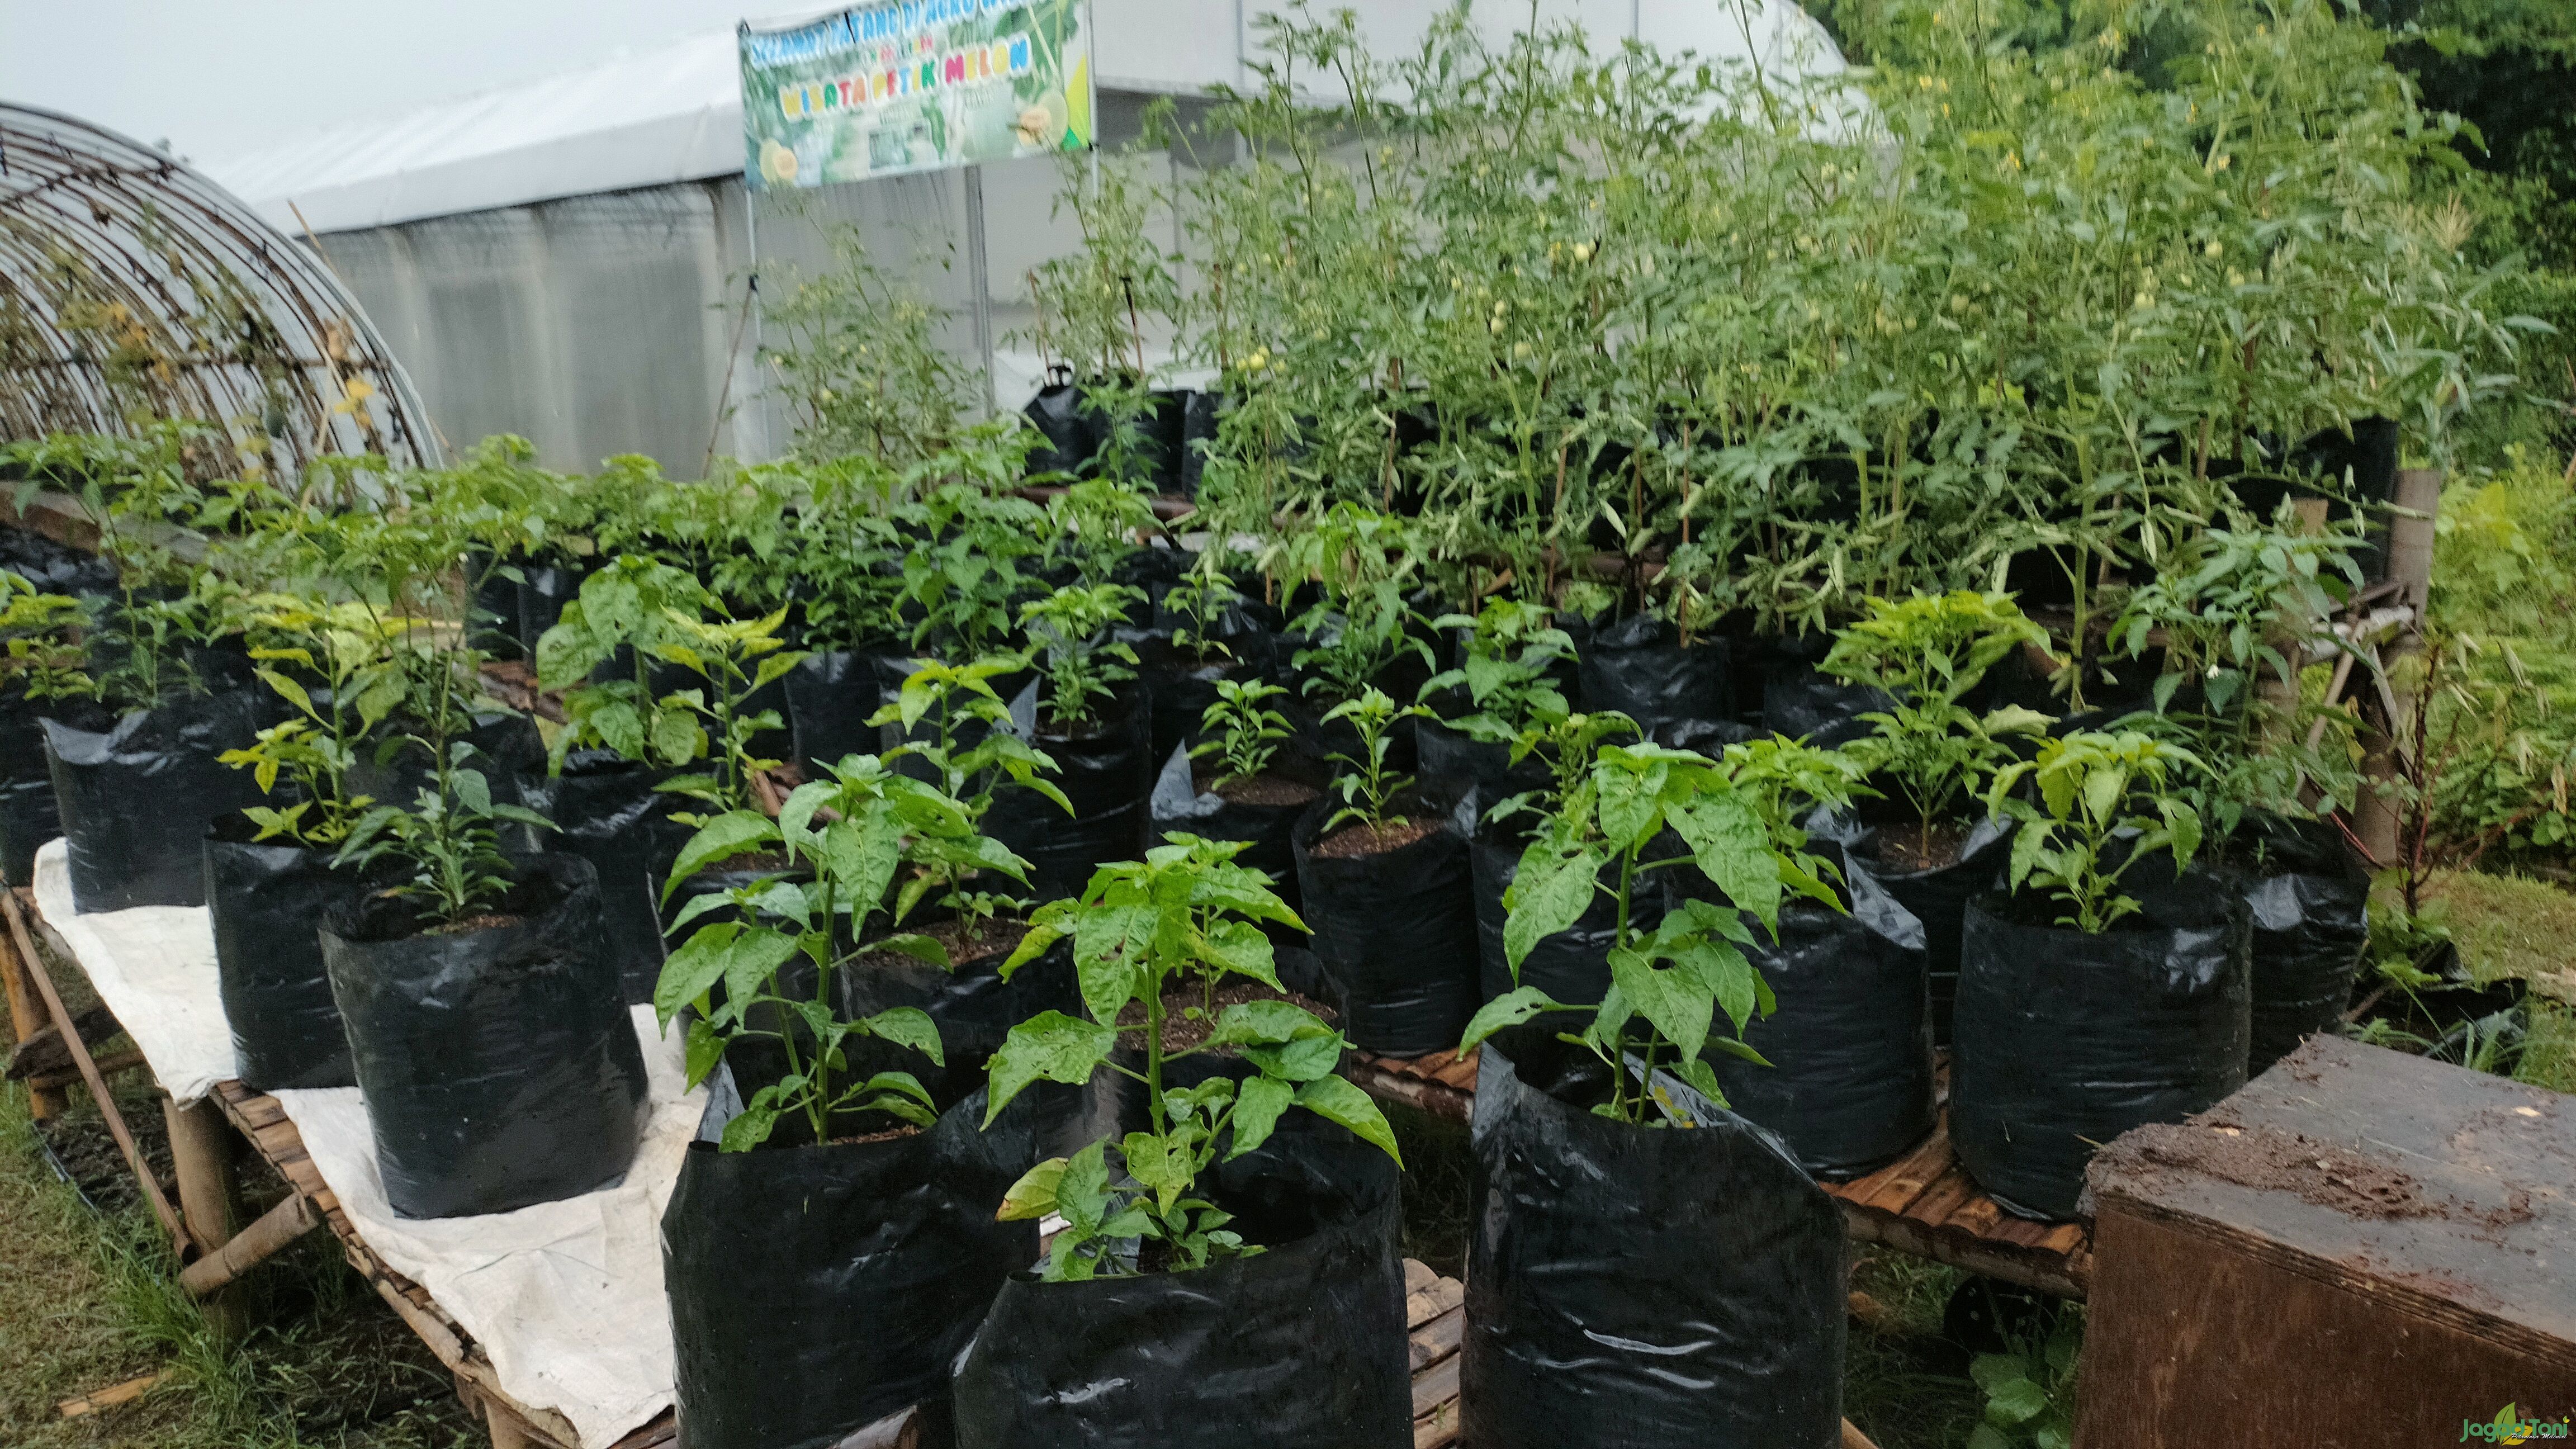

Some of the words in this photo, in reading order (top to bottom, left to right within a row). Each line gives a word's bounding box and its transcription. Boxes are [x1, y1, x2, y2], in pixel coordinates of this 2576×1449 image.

[782, 77, 866, 116] WISATA
[872, 59, 936, 100] PETIK
[945, 39, 1028, 84] MELON
